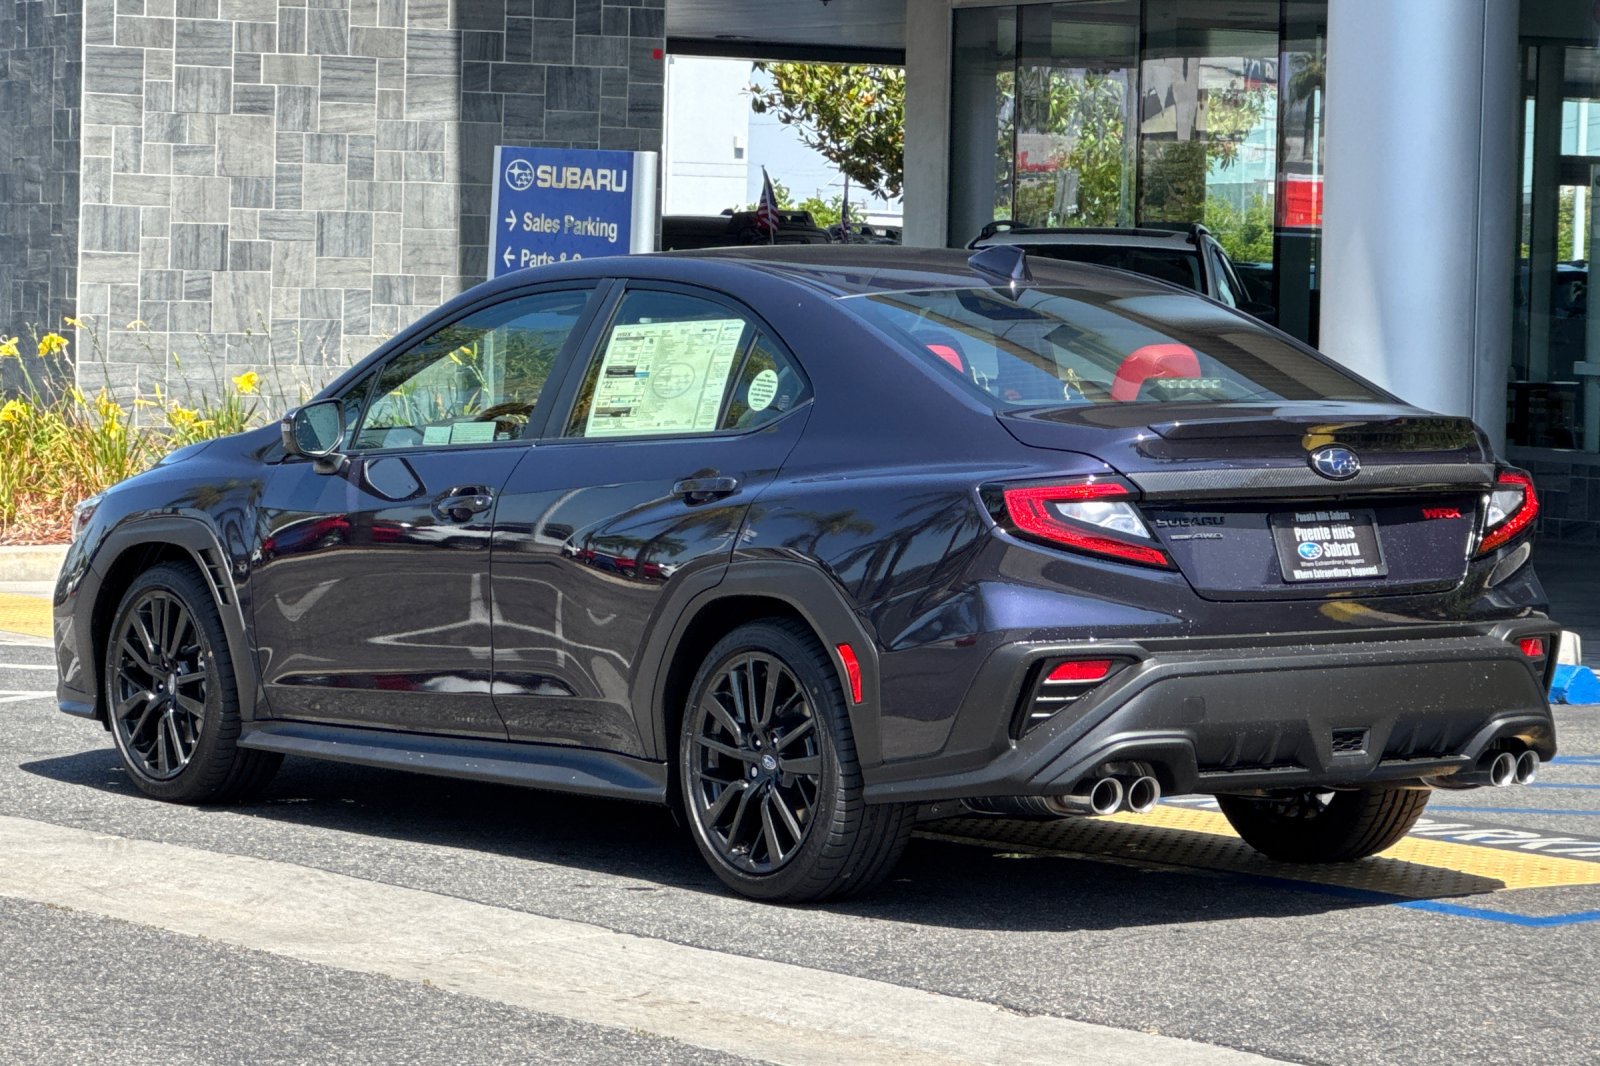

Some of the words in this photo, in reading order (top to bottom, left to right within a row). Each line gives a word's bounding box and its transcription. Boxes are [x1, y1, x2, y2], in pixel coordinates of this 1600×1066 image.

[536, 164, 628, 193] SUBARU
[522, 211, 561, 234] Sales
[563, 214, 619, 243] Parking
[1422, 508, 1462, 519] WRX
[1192, 532, 1224, 540] AWD
[1294, 526, 1332, 542] Puente
[1331, 524, 1356, 540] Hills
[1323, 541, 1361, 558] Subaru
[1293, 569, 1314, 580] Where
[1313, 567, 1352, 579] Extraordinary
